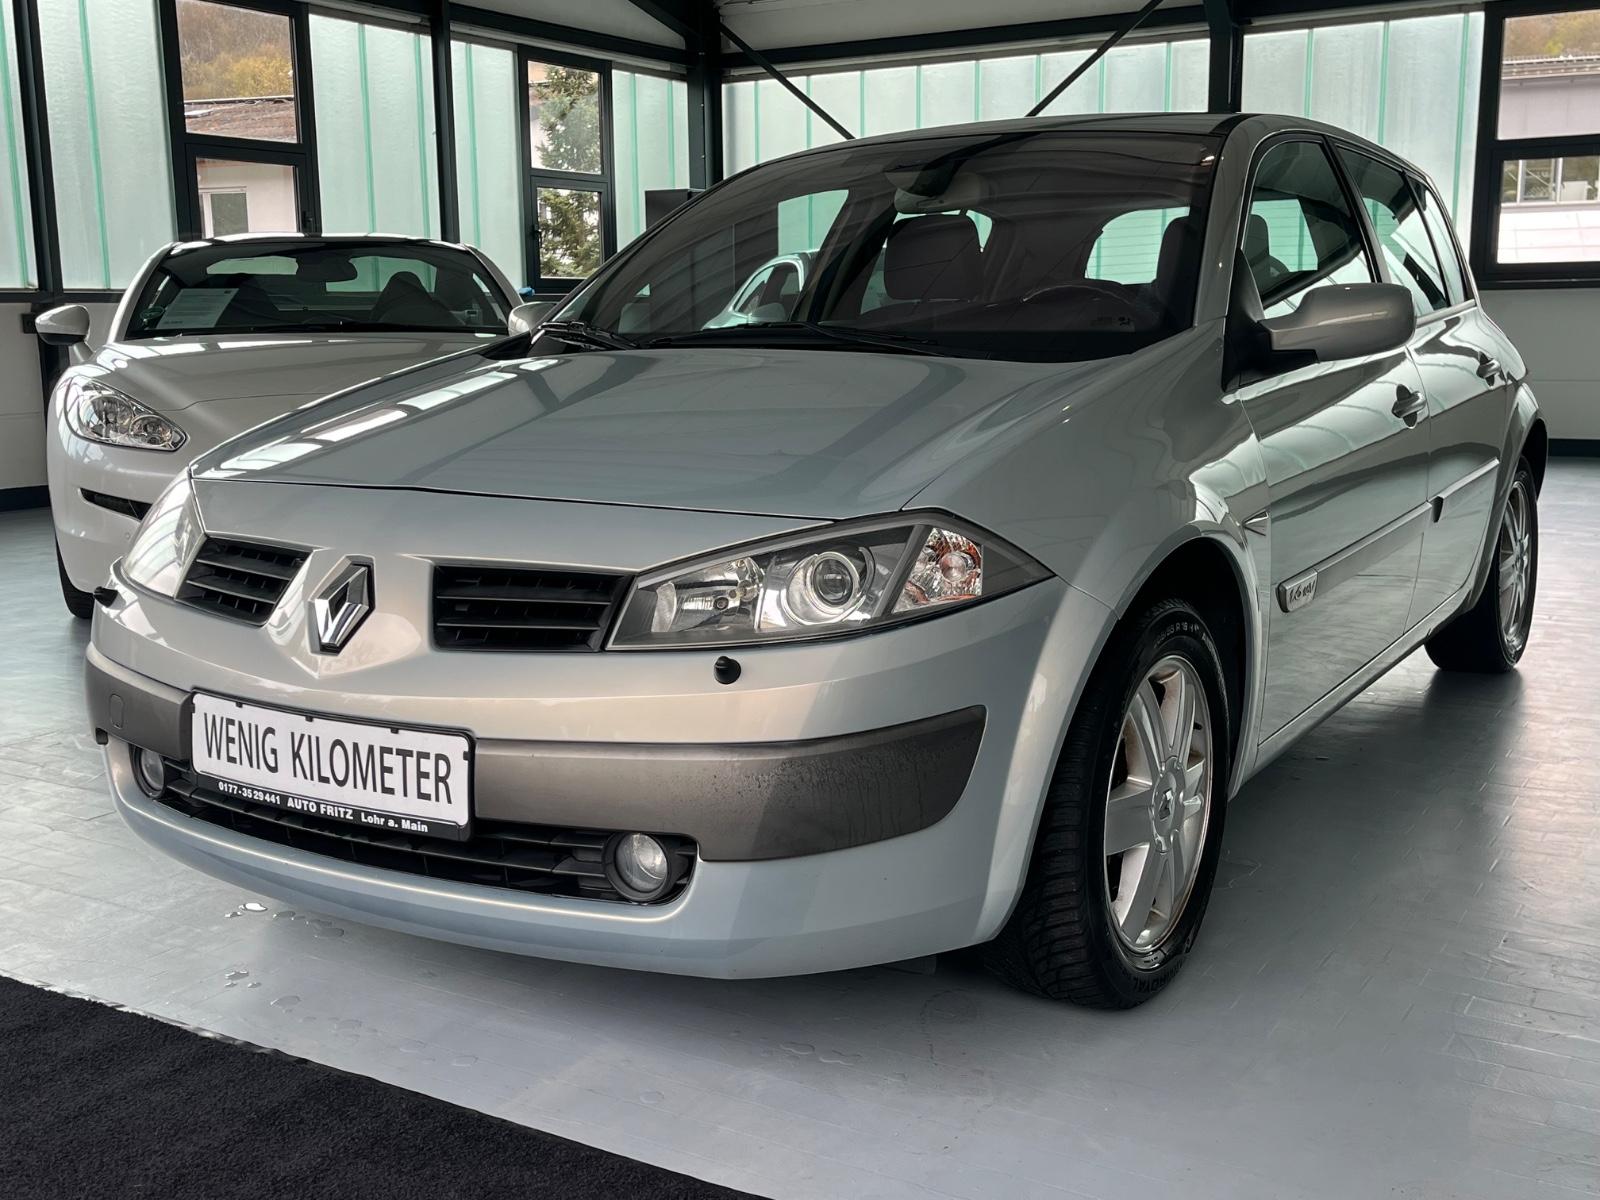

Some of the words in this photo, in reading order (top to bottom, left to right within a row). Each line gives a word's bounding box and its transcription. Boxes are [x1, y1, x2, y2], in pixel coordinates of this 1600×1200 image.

[204, 712, 279, 774] WENIG
[290, 731, 453, 805] KILOMETER
[287, 797, 317, 814] AUTO
[320, 804, 354, 820] FRITZ
[361, 812, 385, 828] Lohr
[387, 818, 399, 829] a.
[401, 818, 428, 833] Main
